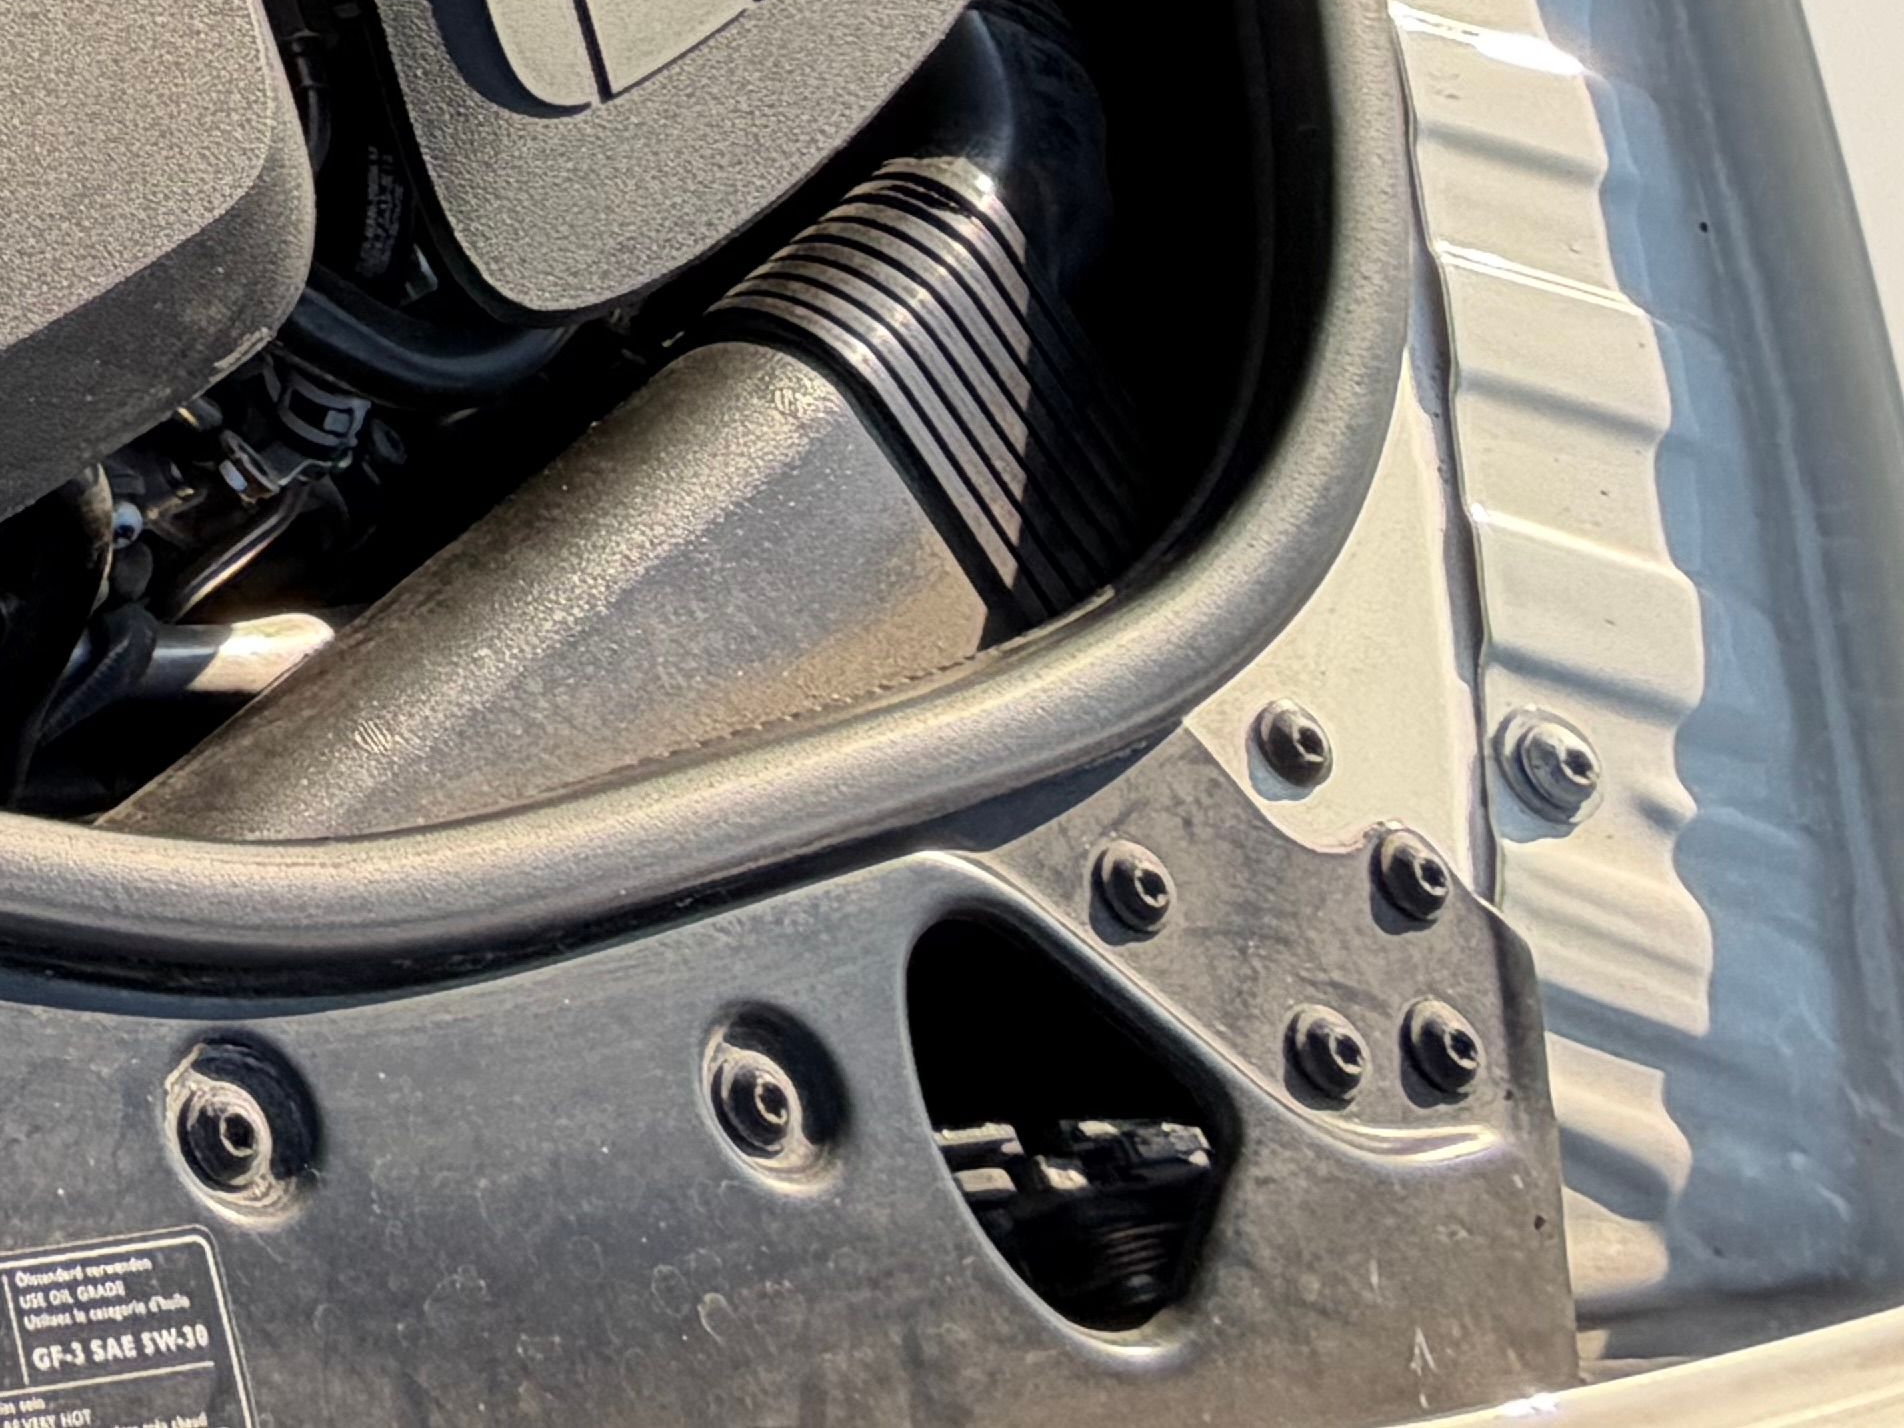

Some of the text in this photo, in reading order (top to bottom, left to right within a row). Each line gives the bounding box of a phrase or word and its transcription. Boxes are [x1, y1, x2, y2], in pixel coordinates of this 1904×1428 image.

[18, 1280, 126, 1310] USE OIL GRADE
[32, 1323, 210, 1372] GF-3 SAE 5W-30
[60, 1408, 93, 1428] HOT
